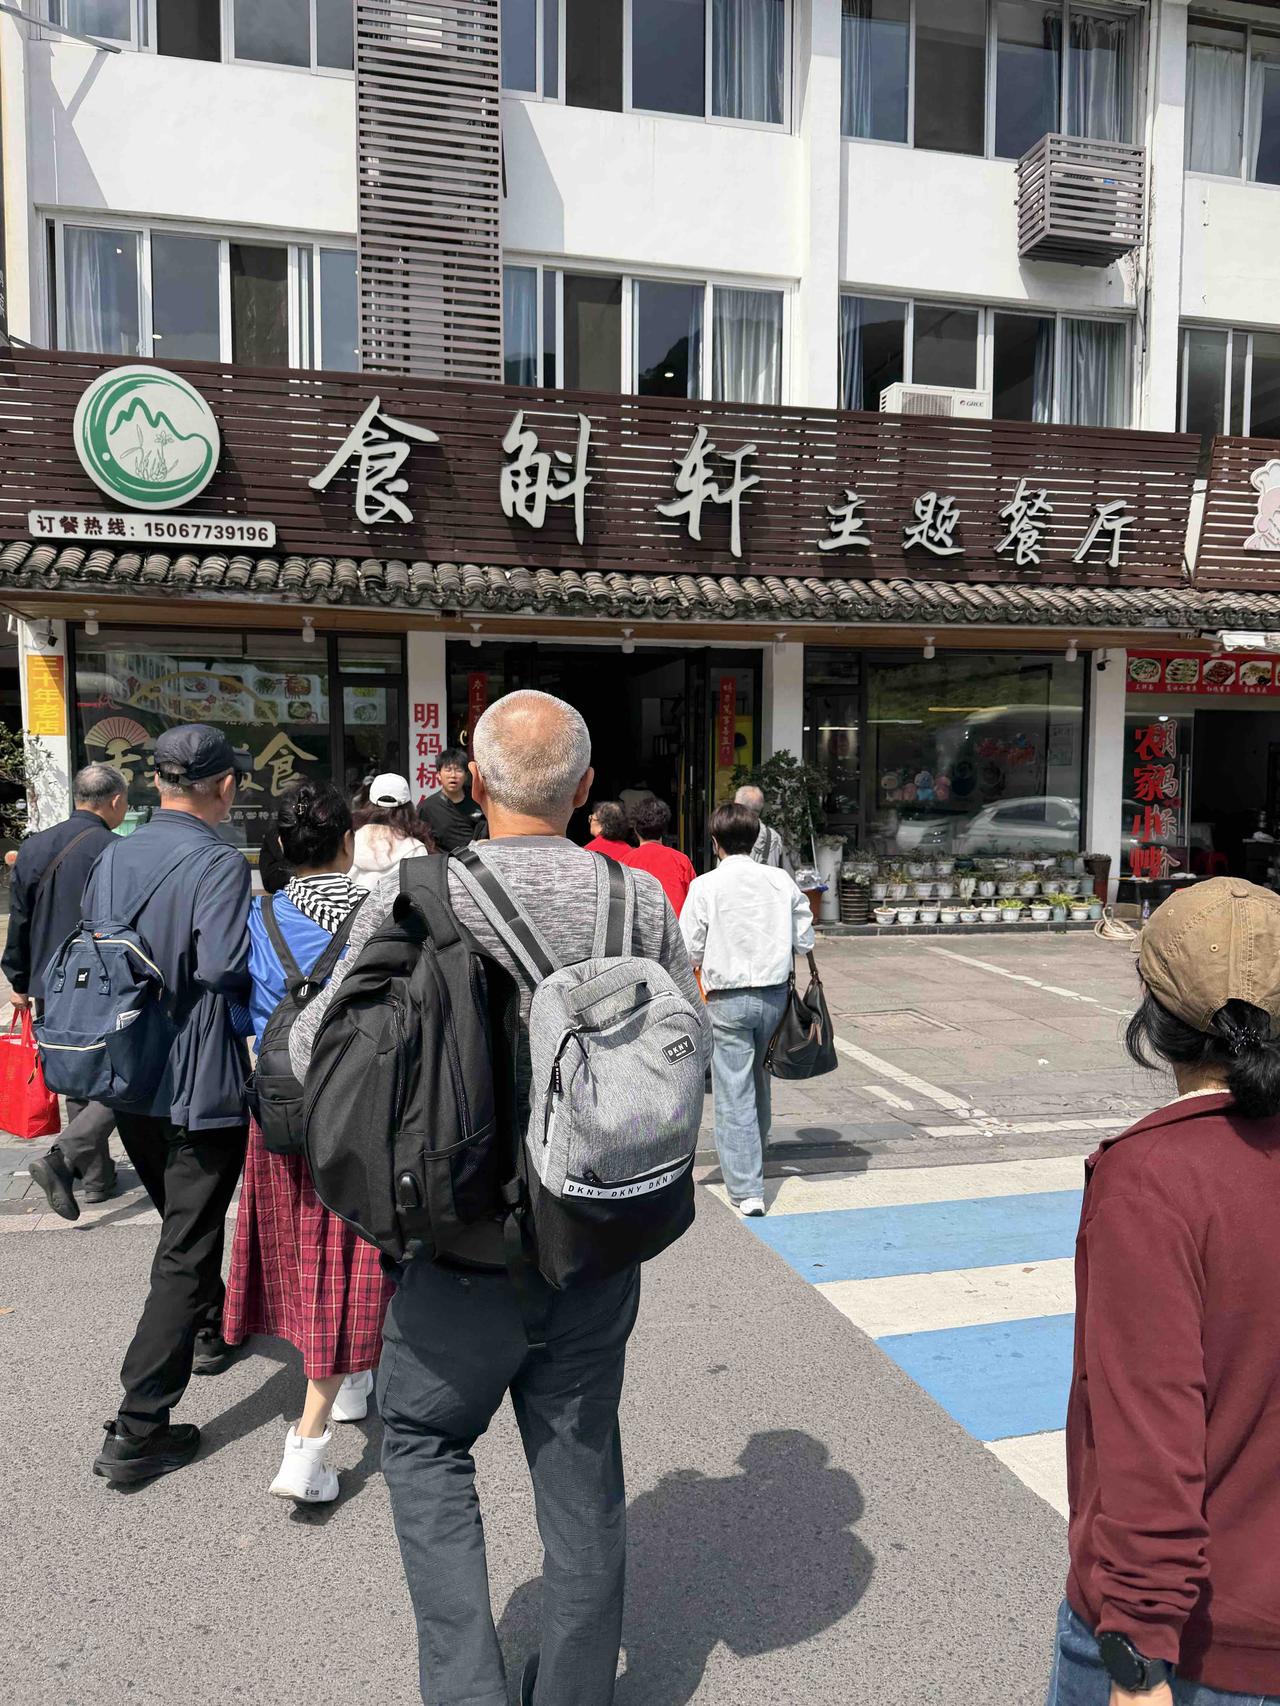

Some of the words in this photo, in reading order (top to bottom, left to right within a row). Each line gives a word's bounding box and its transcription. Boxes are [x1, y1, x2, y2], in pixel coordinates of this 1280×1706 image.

[817, 477, 1135, 568] 主题餐厅
[32, 657, 60, 734] 三十年老店
[414, 703, 442, 807] 明码标
[667, 1040, 688, 1056] DKNY
[568, 1184, 602, 1196] DKNY
[611, 1185, 642, 1198] DKNY
[648, 1174, 676, 1189] DKNY
